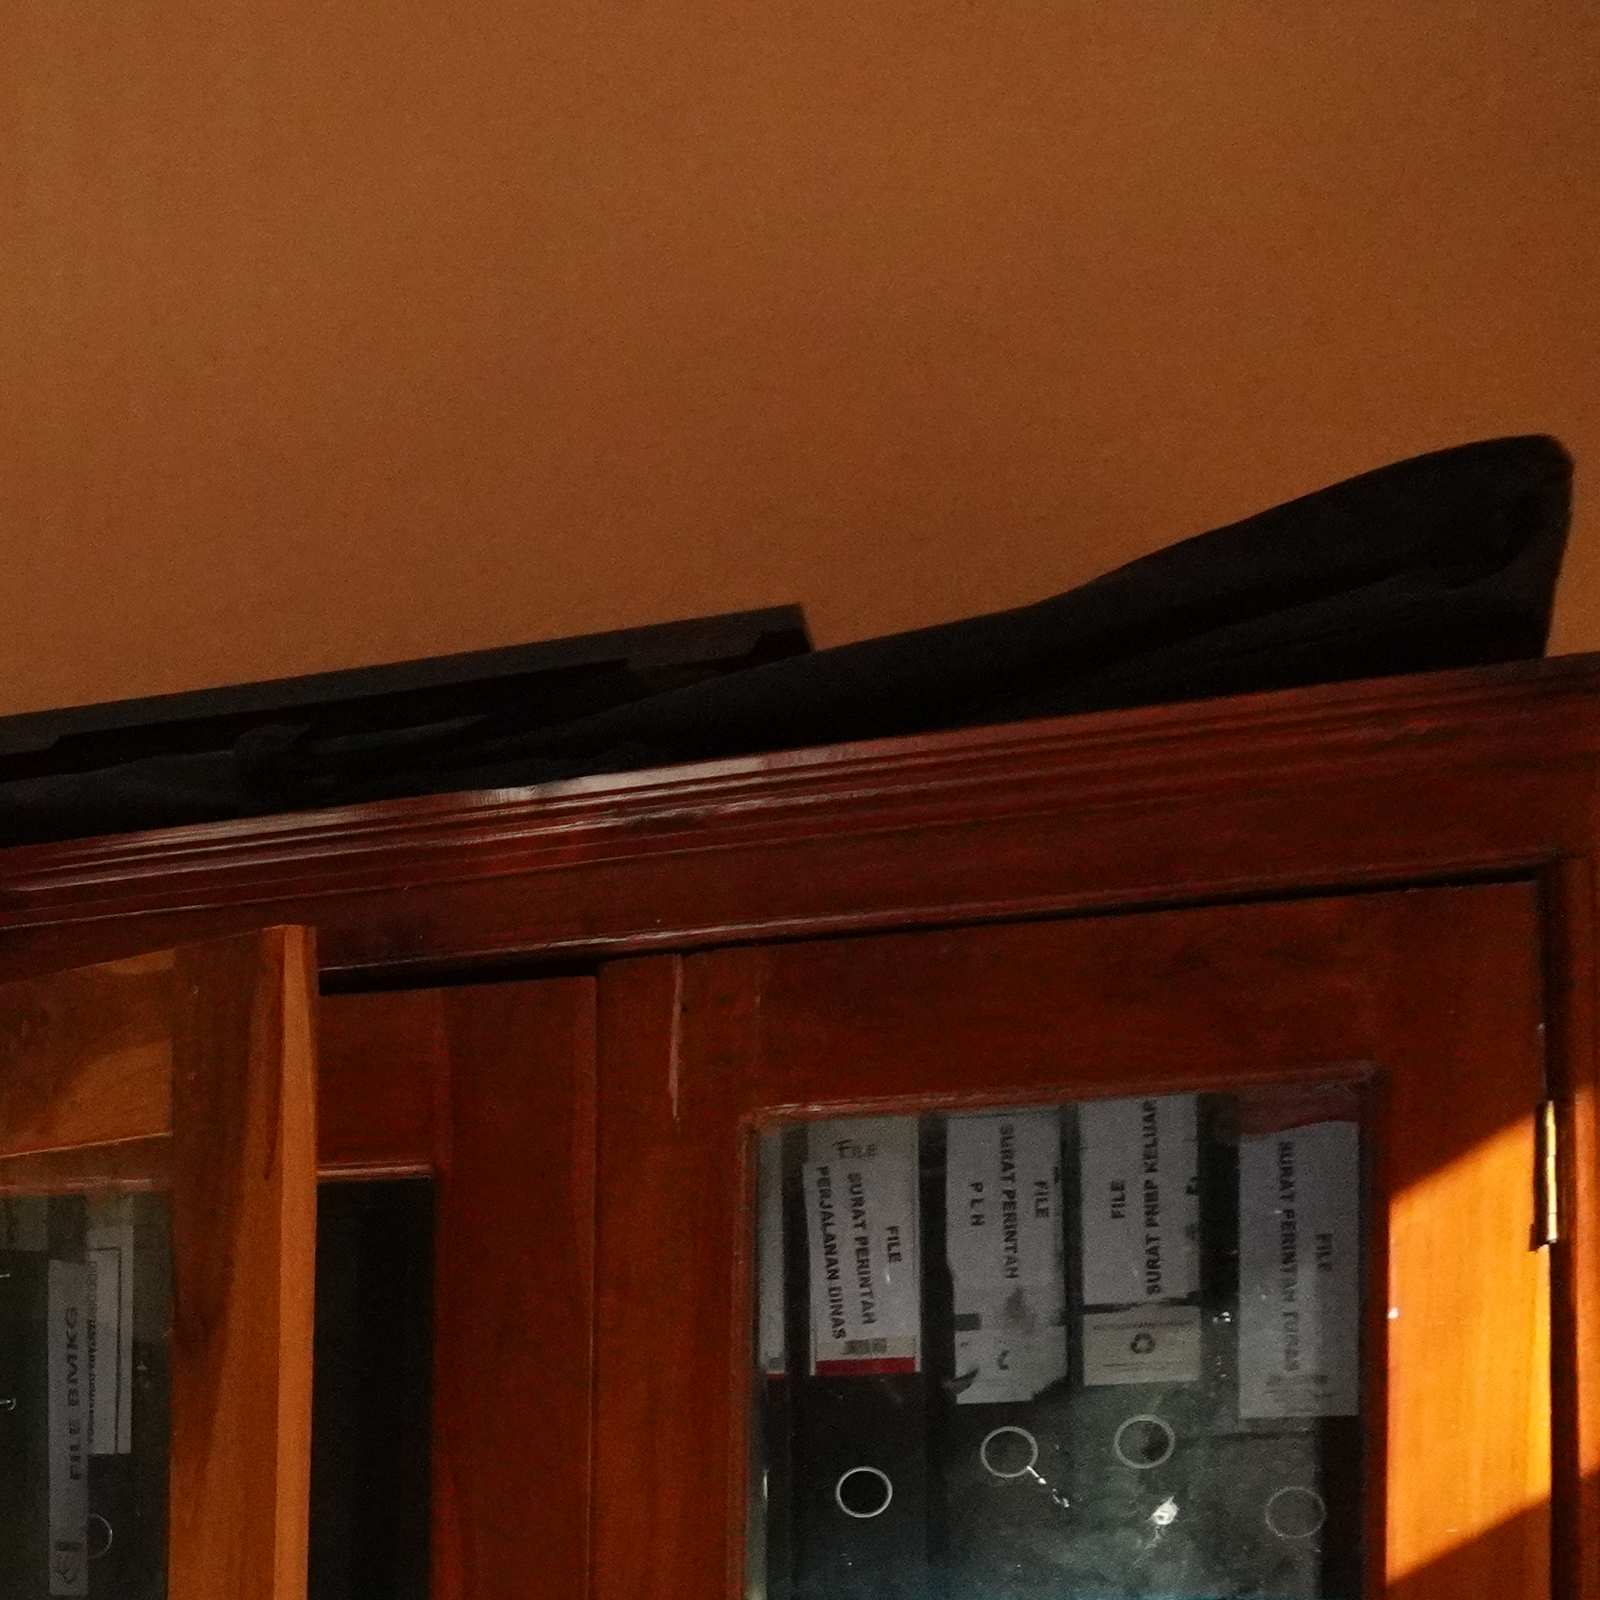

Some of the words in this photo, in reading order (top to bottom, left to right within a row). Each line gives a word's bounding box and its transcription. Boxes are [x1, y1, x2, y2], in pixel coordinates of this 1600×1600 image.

[1001, 1125, 1016, 1183] SURAT
[848, 1173, 866, 1229] SURAT
[1035, 1181, 1048, 1217] FILE
[1111, 1180, 1125, 1219] FILE
[817, 1166, 839, 1280] PERJALANAN
[831, 1287, 846, 1339] DINAS
[887, 1227, 901, 1262] FILE
[1003, 1190, 1019, 1279] PERINTAH
[855, 1237, 876, 1324] PERINTAH
[1145, 1234, 1161, 1295] SURAT
[65, 1306, 80, 1407] BMKG
